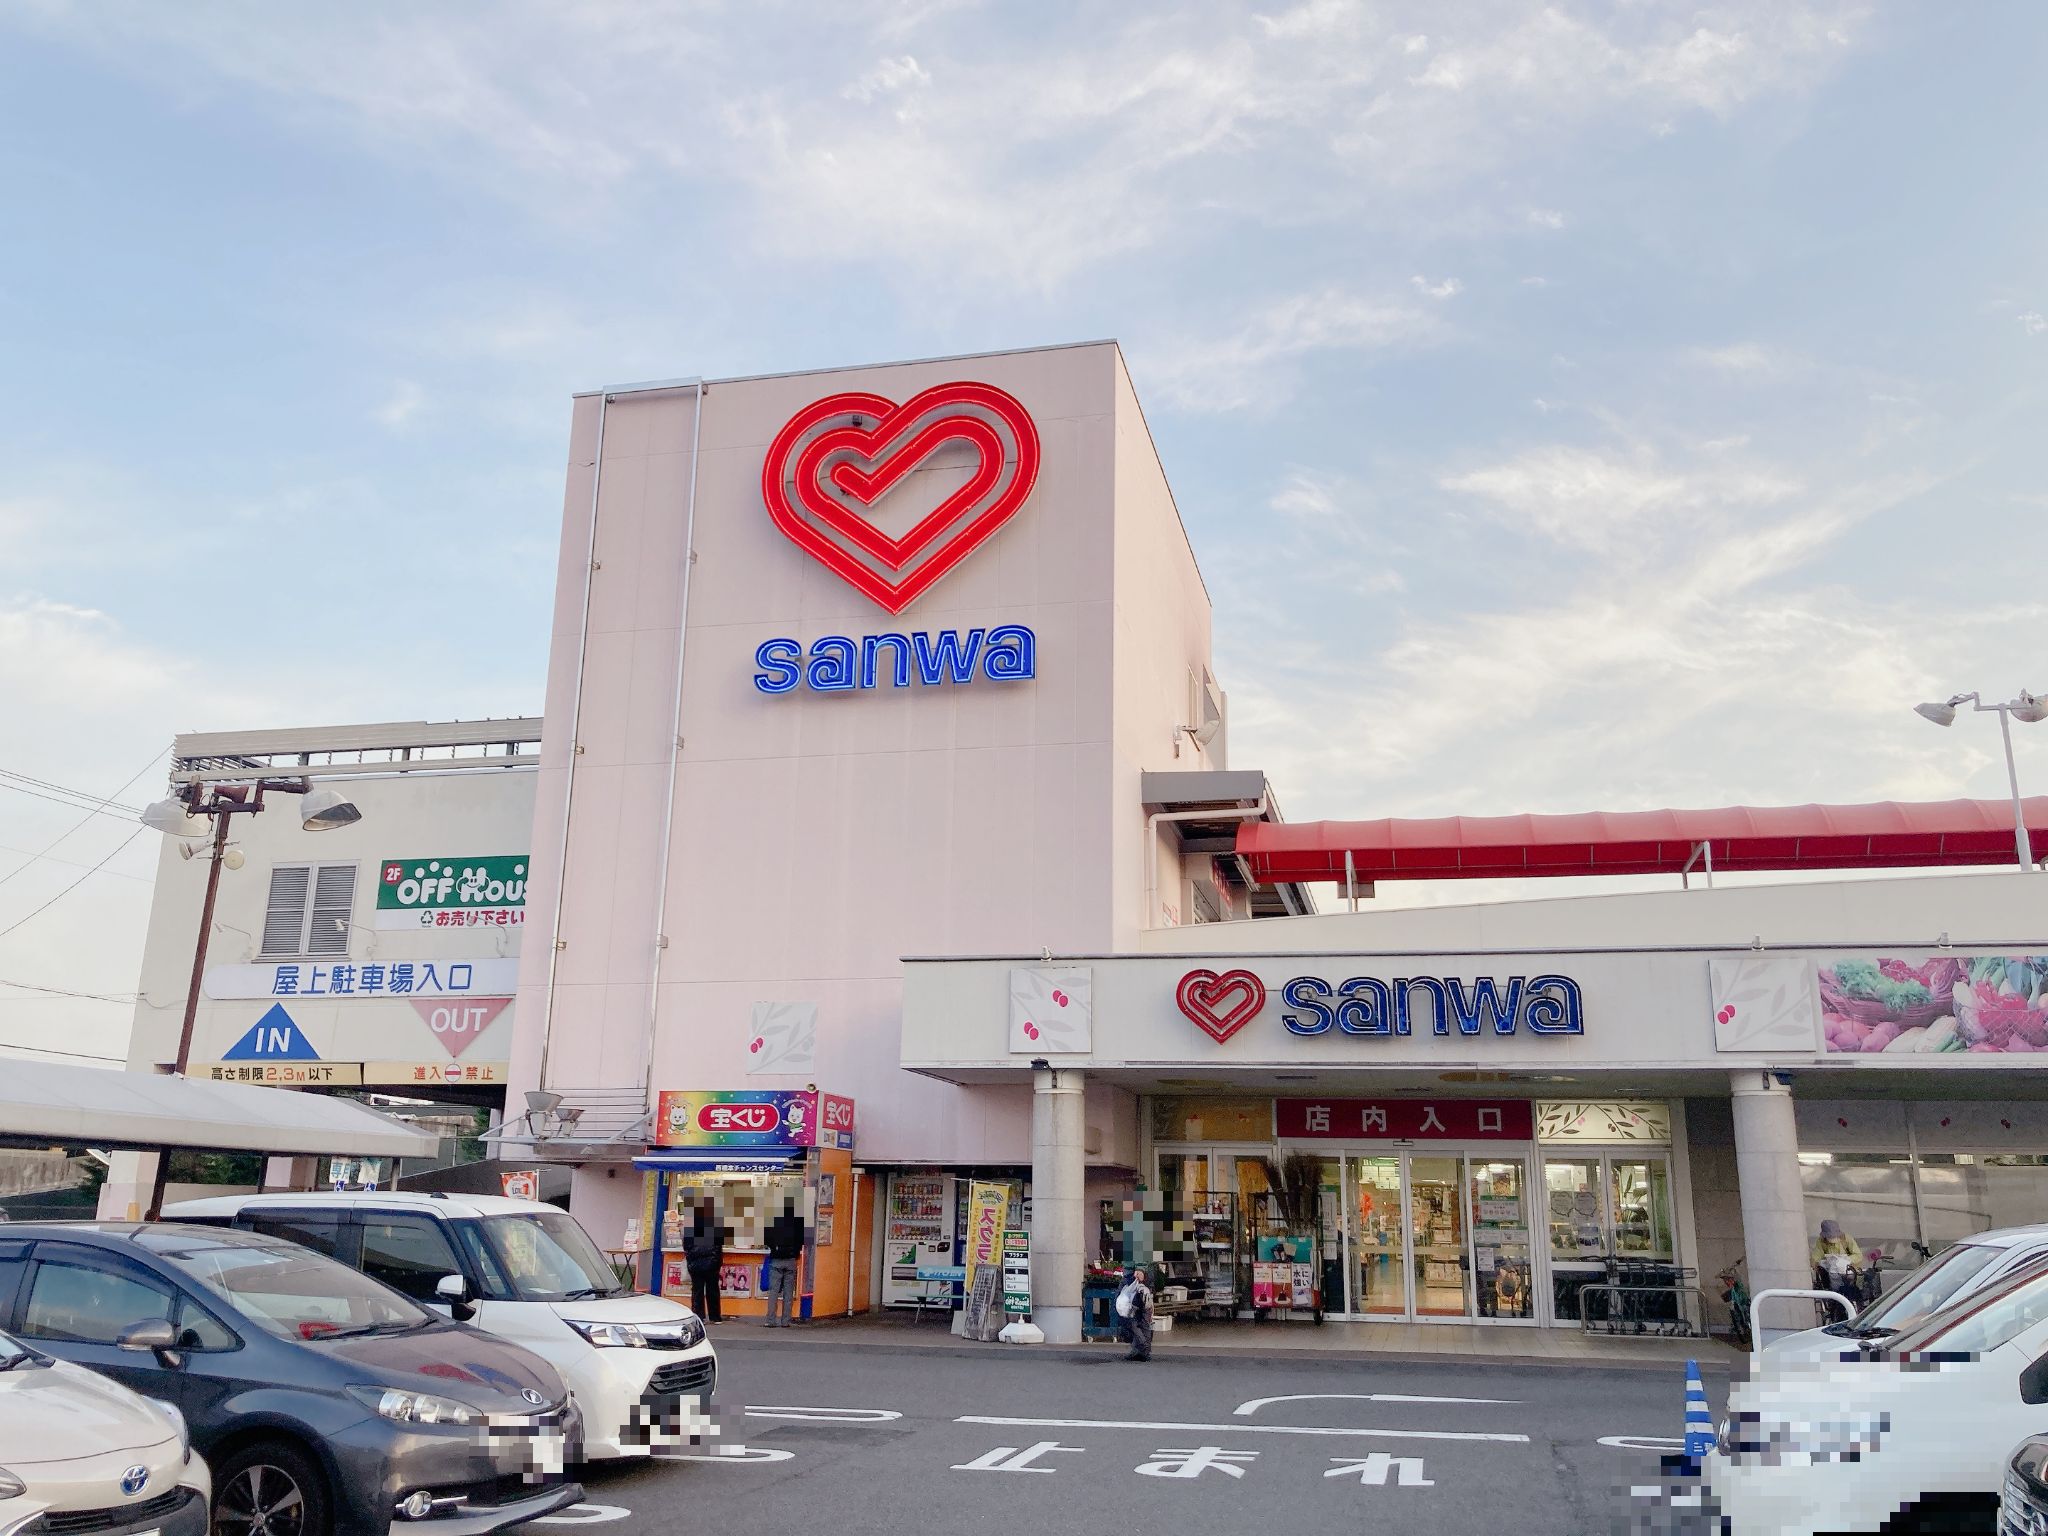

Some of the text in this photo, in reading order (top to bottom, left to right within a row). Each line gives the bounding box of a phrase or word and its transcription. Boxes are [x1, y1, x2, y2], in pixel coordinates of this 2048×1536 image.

[754, 624, 1037, 694] sanwa
[386, 868, 401, 881] 2F
[397, 876, 455, 905] OFF
[436, 910, 525, 927] お売り下さい
[272, 963, 473, 995] 屋上駐車場入口
[1282, 974, 1584, 1037] sanwa
[430, 1007, 488, 1033] OUT
[255, 1026, 291, 1054] IN
[710, 1108, 766, 1128] 宝くじ
[825, 1100, 851, 1127] 宝くじ
[1305, 1105, 1503, 1133] 店内入口
[948, 1441, 1435, 1486] 止まれ
